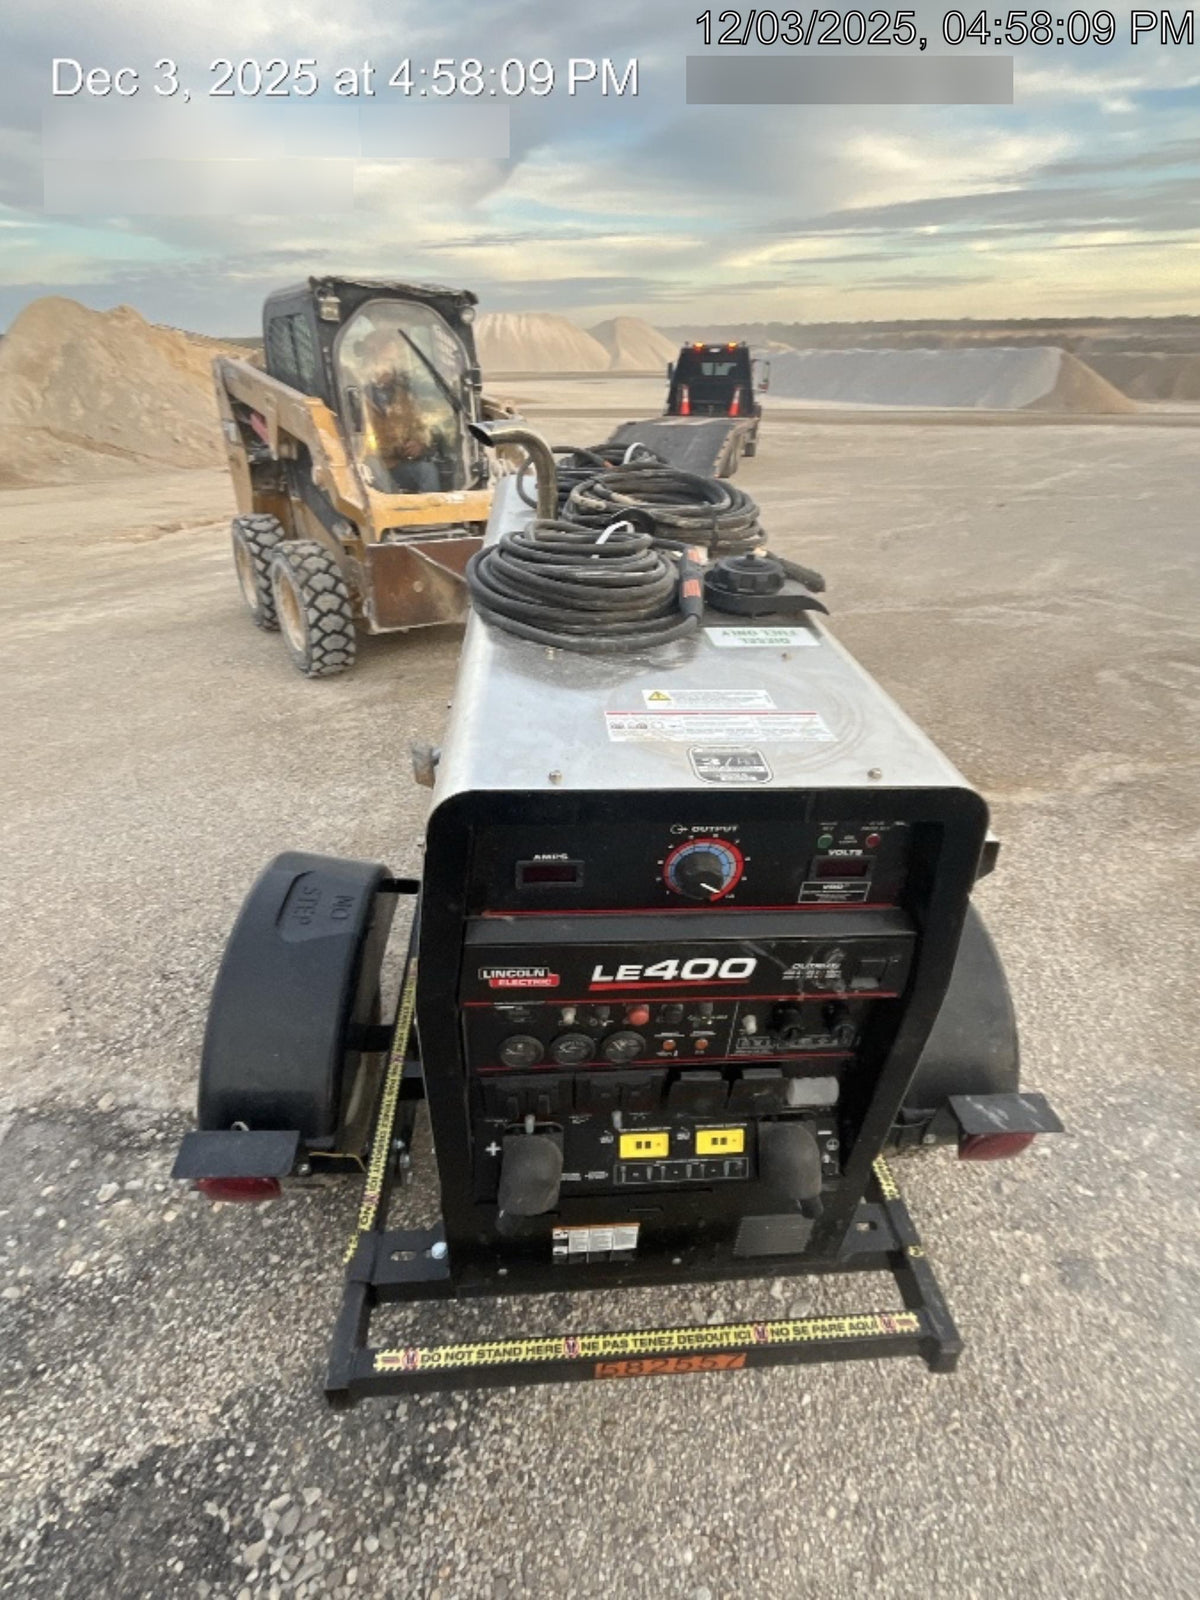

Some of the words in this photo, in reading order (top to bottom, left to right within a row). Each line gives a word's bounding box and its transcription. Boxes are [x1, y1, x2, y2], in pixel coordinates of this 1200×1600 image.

[291, 885, 321, 926] STEP
[330, 895, 356, 921] NO
[483, 968, 545, 979] LINCOLN
[591, 958, 757, 982] LE400
[498, 978, 553, 986] ELECTRIC
[770, 1327, 790, 1337] NO
[793, 1325, 809, 1335] SE
[812, 1322, 845, 1333] PARE
[581, 1341, 599, 1351] NE
[603, 1338, 629, 1350] PAS
[632, 1336, 674, 1348] TENEZ
[677, 1331, 730, 1345] DEBOUT
[734, 1330, 751, 1341] ICI
[421, 1352, 441, 1363] DO
[444, 1350, 473, 1362] NOT
[476, 1347, 522, 1360] STAND
[526, 1343, 563, 1355] HERE
